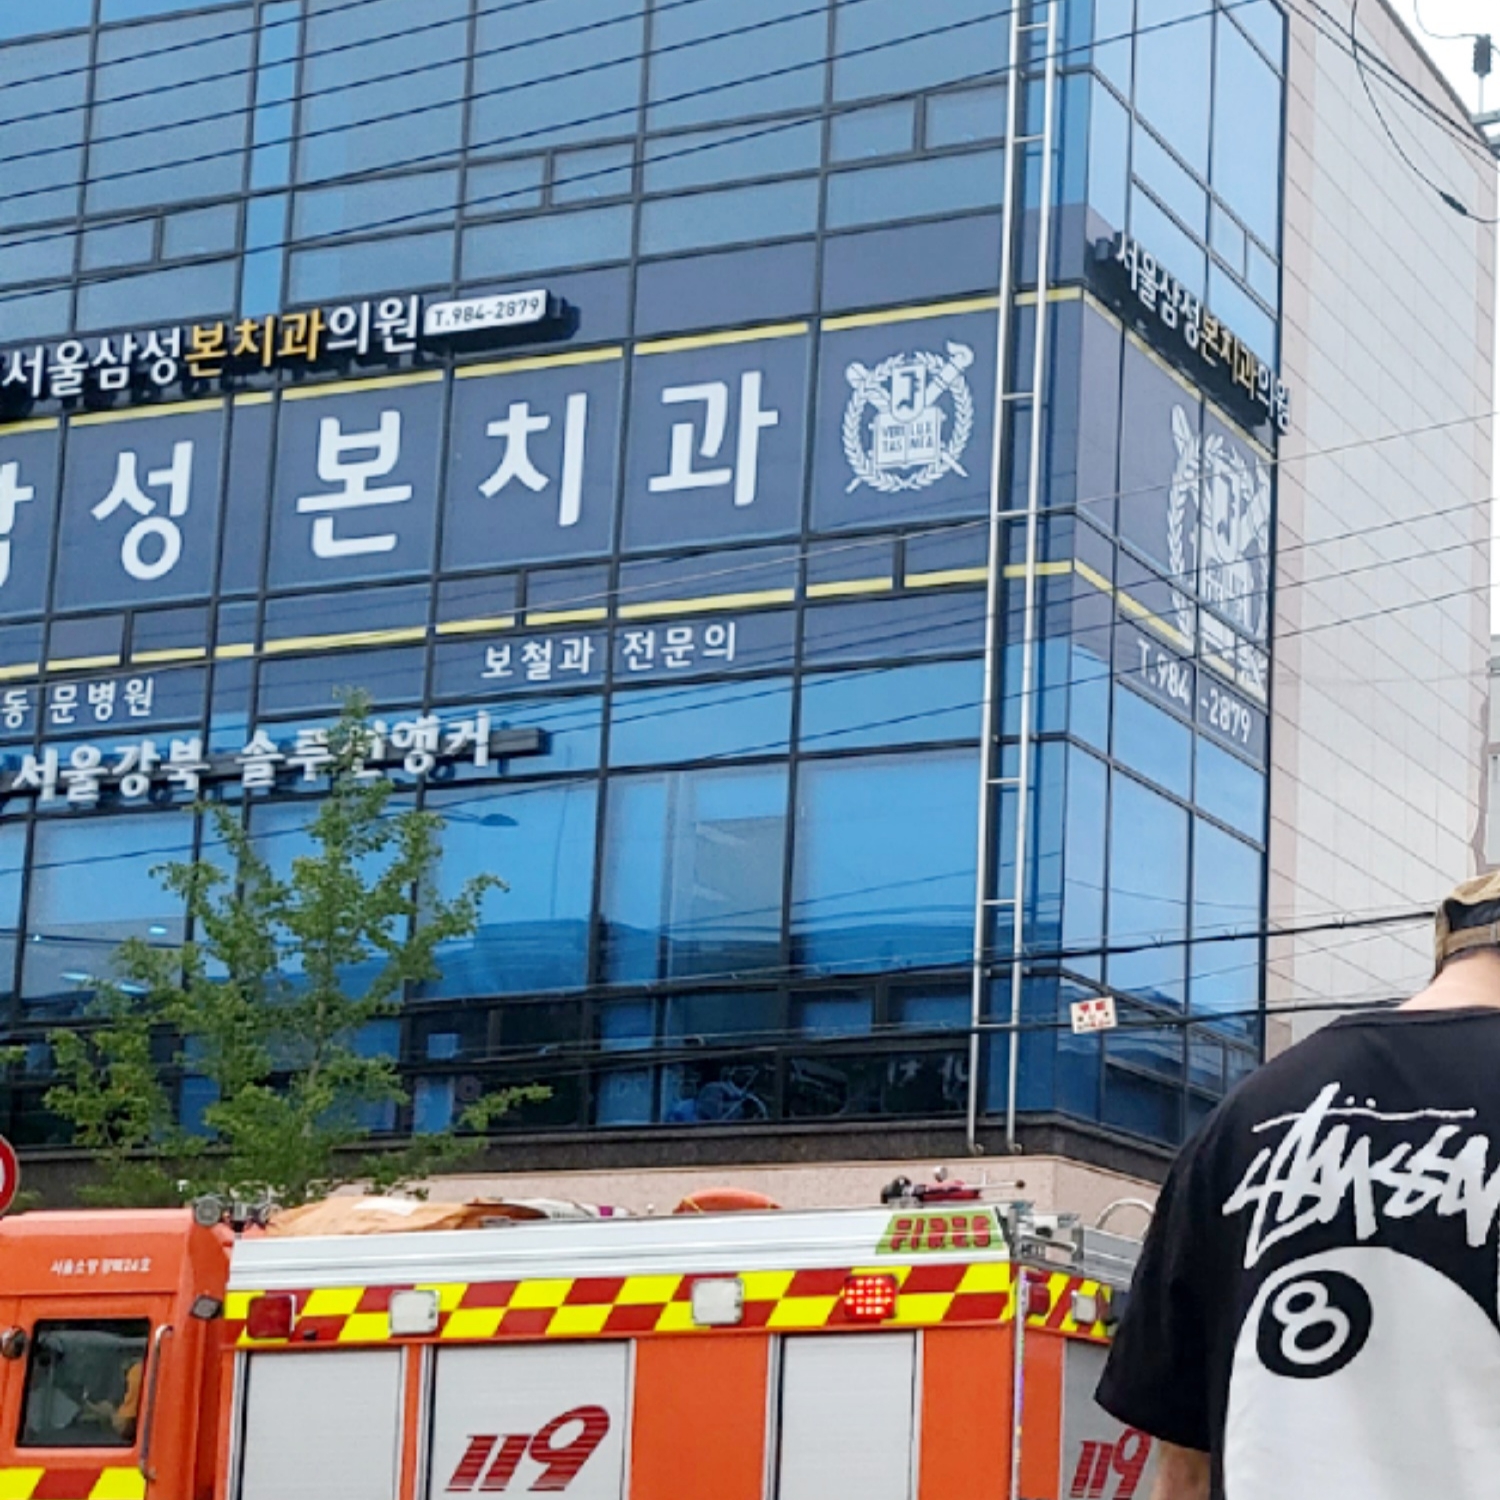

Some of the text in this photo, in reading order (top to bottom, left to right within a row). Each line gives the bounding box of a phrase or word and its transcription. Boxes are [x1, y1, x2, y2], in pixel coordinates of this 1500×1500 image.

[2, 294, 539, 397] 서울삼성본치과의원 T.984-2879
[480, 621, 737, 681] 보철과 전문의
[11, 737, 211, 801] 서울강북
[1271, 1280, 1351, 1365] 8
[444, 1404, 611, 1492] 119
